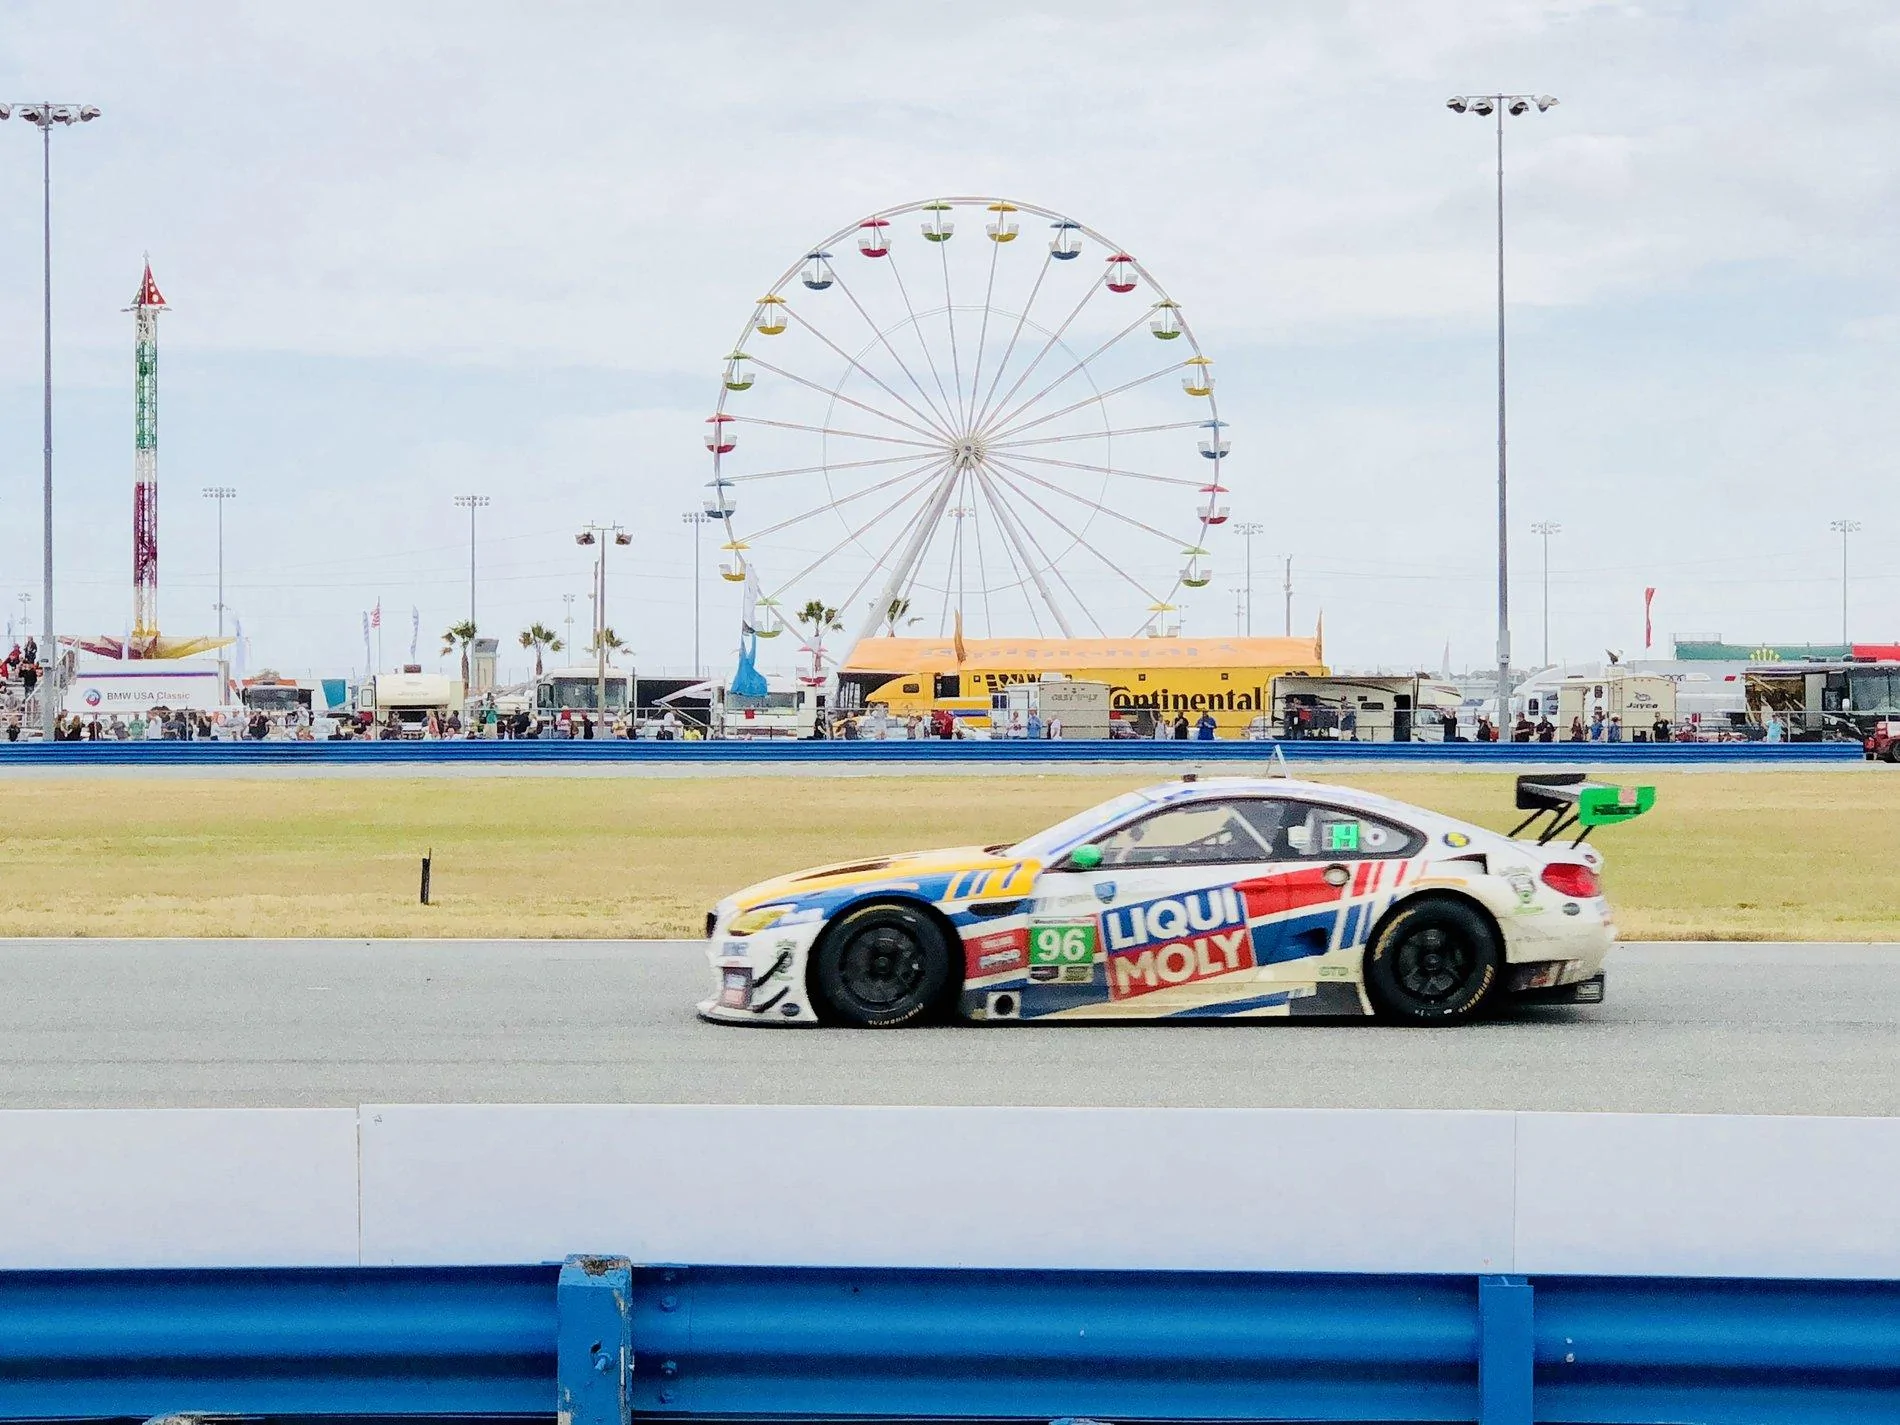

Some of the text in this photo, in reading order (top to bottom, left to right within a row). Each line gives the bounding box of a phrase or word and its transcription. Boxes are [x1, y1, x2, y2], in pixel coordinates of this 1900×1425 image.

[107, 692, 190, 701] BMW USA Classic
[1107, 888, 1240, 950] LIQUI
[1037, 929, 1086, 962] 96
[1115, 929, 1246, 994] MOLY
